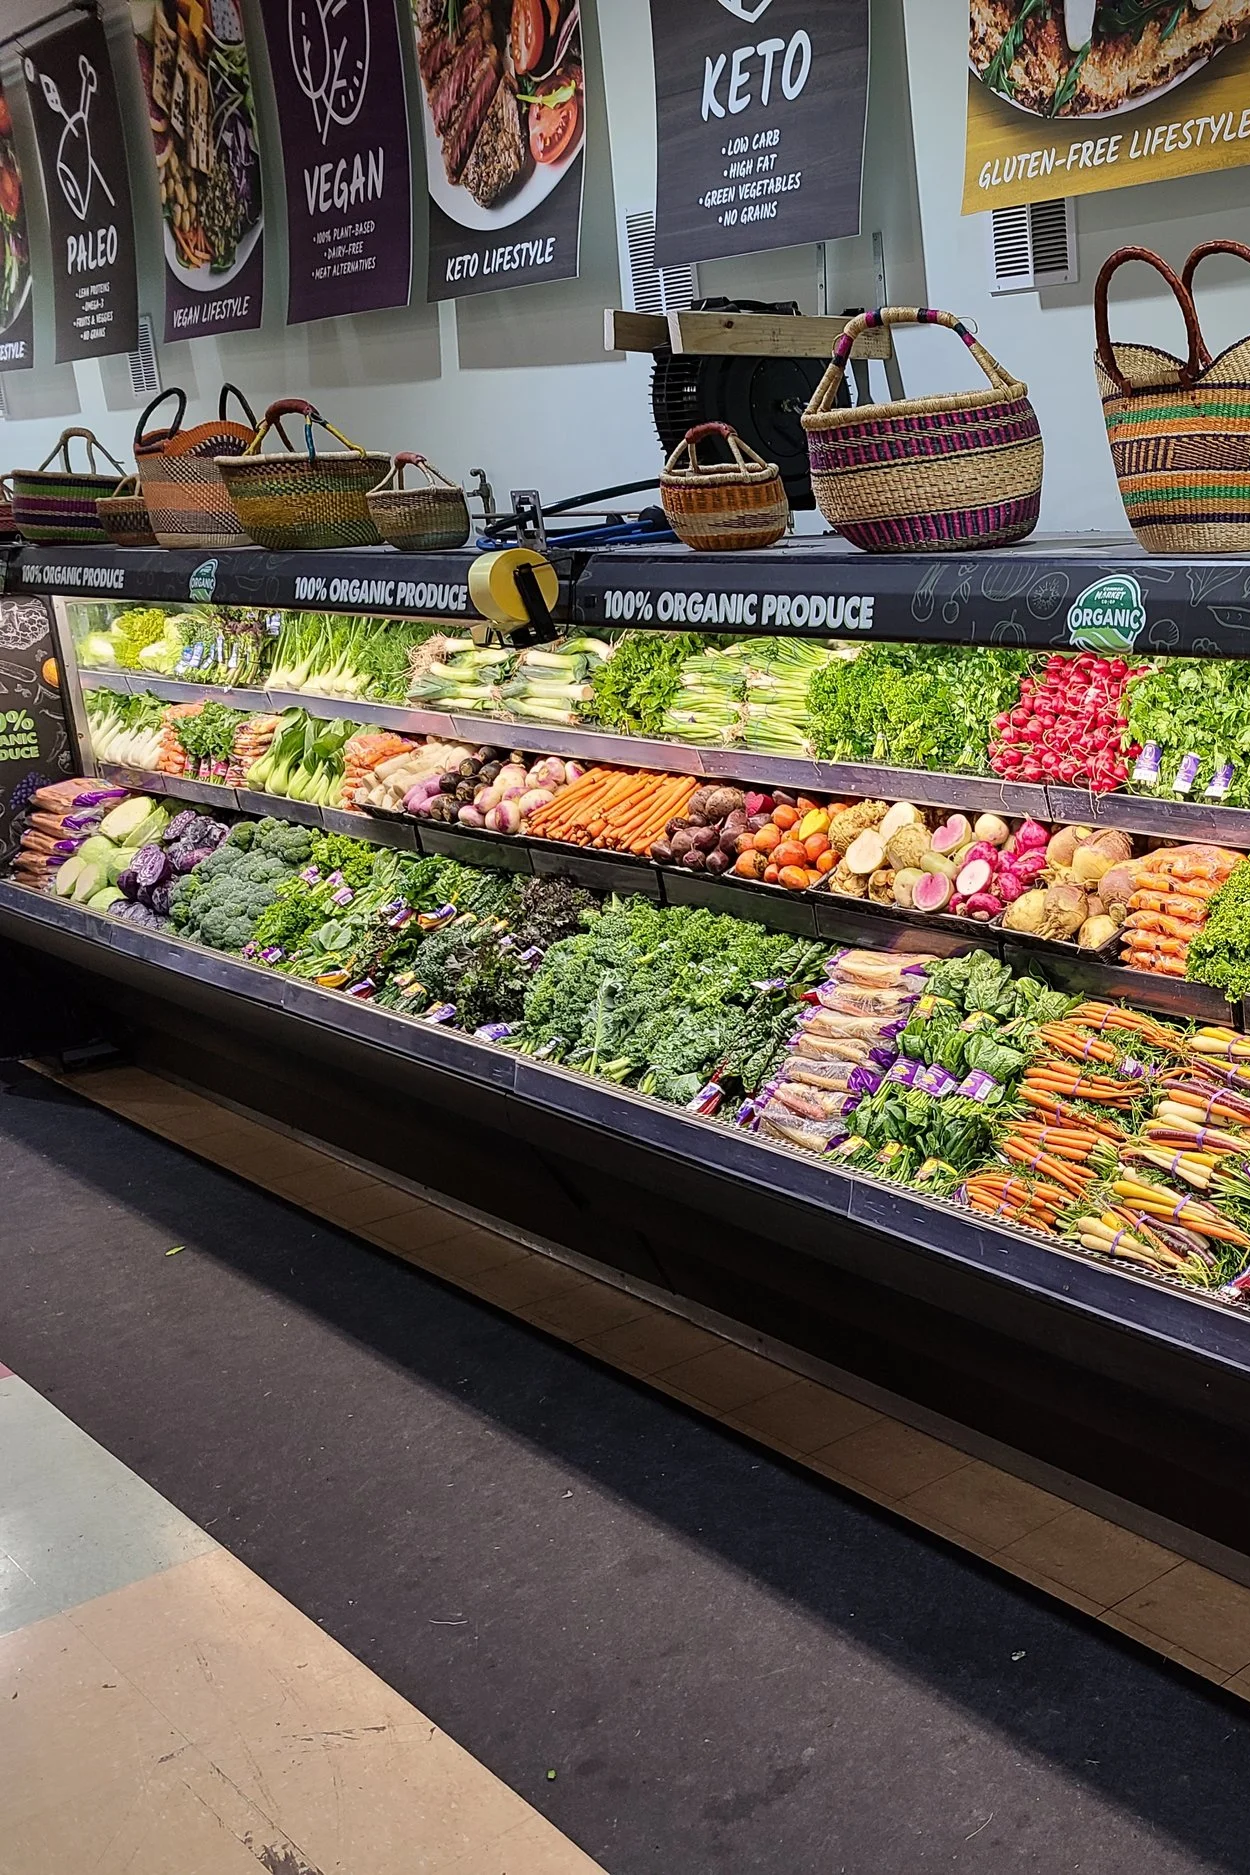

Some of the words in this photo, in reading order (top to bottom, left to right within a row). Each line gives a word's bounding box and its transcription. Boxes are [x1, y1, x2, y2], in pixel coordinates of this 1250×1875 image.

[701, 29, 812, 122] KETO
[727, 135, 749, 156] LOW
[752, 128, 780, 151] CARB
[729, 157, 753, 179] HIGH
[756, 153, 778, 173] FAT
[978, 134, 1123, 190] GLUTEN-FREE
[304, 146, 384, 216] VEGAN
[704, 185, 736, 208] GREEN
[738, 171, 802, 199] VEGETABLES
[723, 207, 738, 227] NO
[740, 200, 778, 224] GRAINS
[316, 229, 332, 245] 100%
[333, 220, 375, 241] PLANT-BASED
[67, 224, 118, 275] PALEO
[327, 241, 364, 260] DAIRY-FREE
[446, 252, 479, 282] KETO
[482, 237, 556, 275] LIFESTYLE
[315, 264, 331, 280] MEAT
[332, 256, 377, 276] ALTERNATIVES
[91, 314, 96, 325] &
[173, 305, 201, 329] VEGAN
[202, 295, 251, 323] LIFESTYLE
[22, 564, 42, 584] 100%
[43, 565, 82, 586] ORGANIC
[82, 567, 125, 589] PRODUCE
[294, 576, 328, 602] 100%
[329, 577, 395, 606] ORGANIC
[396, 581, 468, 611] PRODUCE
[1094, 590, 1127, 602] MARKET
[604, 590, 652, 621] 100%
[656, 591, 758, 624] ORGANIC
[761, 594, 875, 630] PRODUCE
[1071, 607, 1141, 630] ORGANIC
